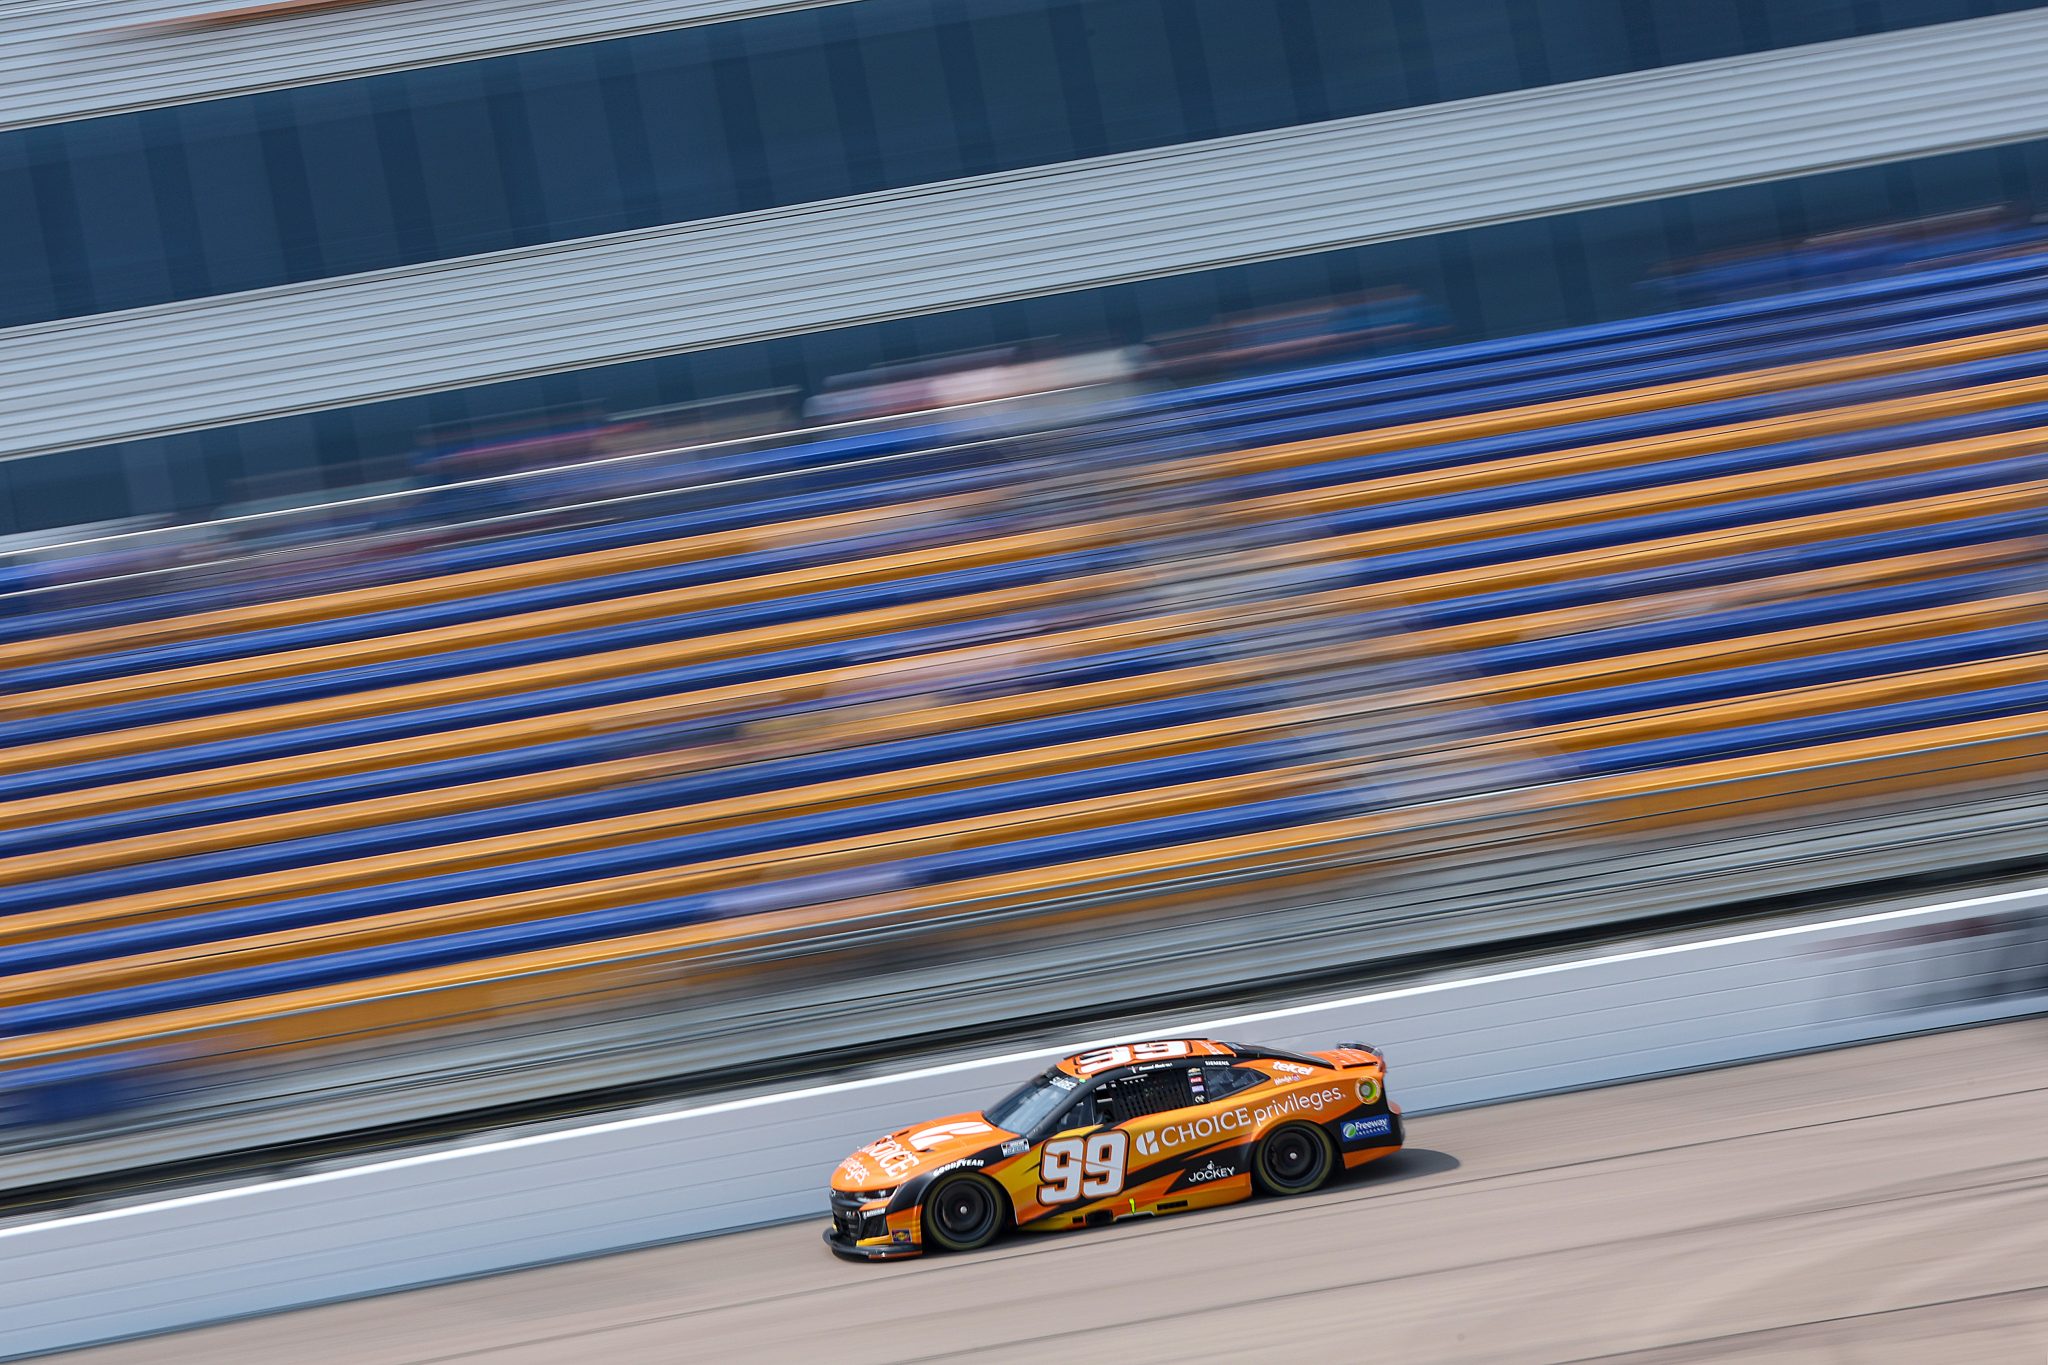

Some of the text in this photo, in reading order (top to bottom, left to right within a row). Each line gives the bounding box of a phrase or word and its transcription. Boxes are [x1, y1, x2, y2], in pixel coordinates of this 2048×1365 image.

[1161, 1107, 1251, 1147] CHOICE
[1355, 1118, 1388, 1131] Freeway
[933, 1158, 985, 1177] GOODYEAR
[1037, 1129, 1130, 1206] 99
[1188, 1165, 1235, 1183] JOCKEY
